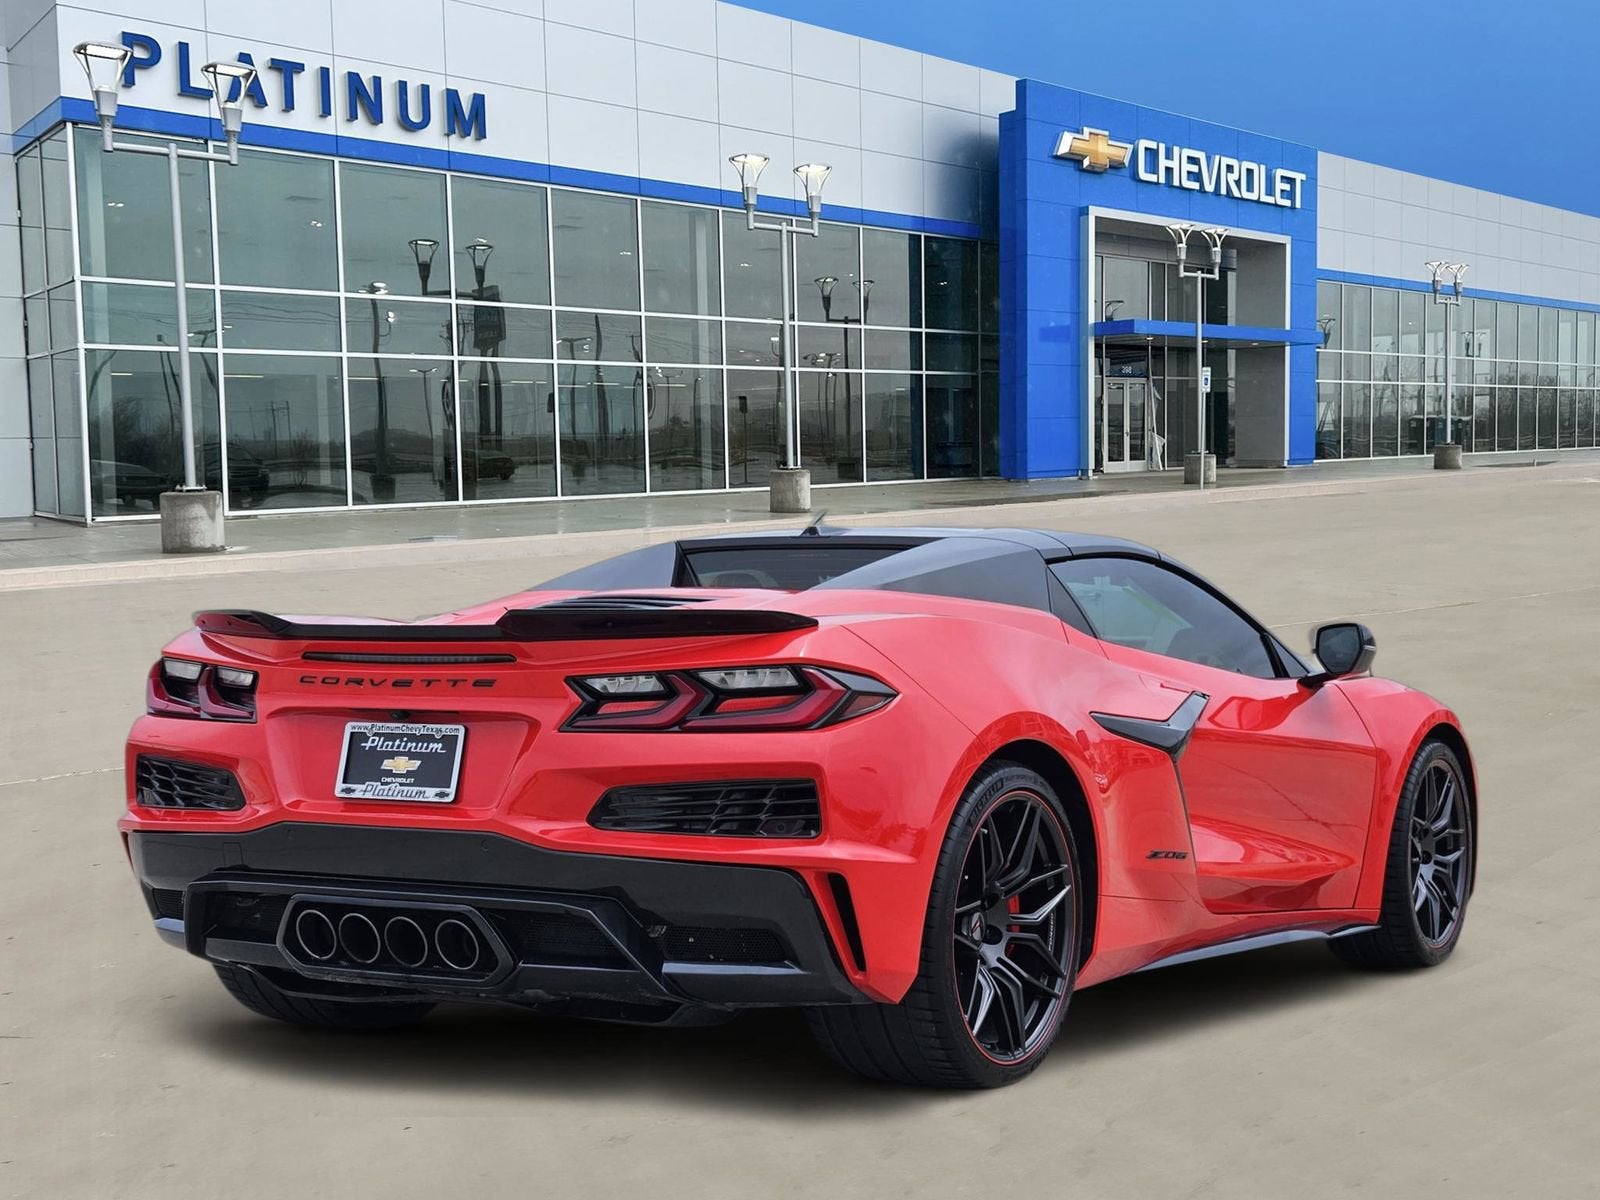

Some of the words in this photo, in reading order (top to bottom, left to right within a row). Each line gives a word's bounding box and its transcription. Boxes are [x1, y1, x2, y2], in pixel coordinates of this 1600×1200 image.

[119, 31, 487, 141] PLATINUM
[1136, 138, 1306, 208] CHEVROLET
[299, 675, 497, 688] CORVETTE
[350, 723, 460, 735] www.PlatinumChevyTexas.com
[361, 736, 446, 753] Platinum
[381, 776, 415, 784] CHEVROLET
[360, 782, 430, 799] Platinum
[1145, 849, 1189, 860] Z06
